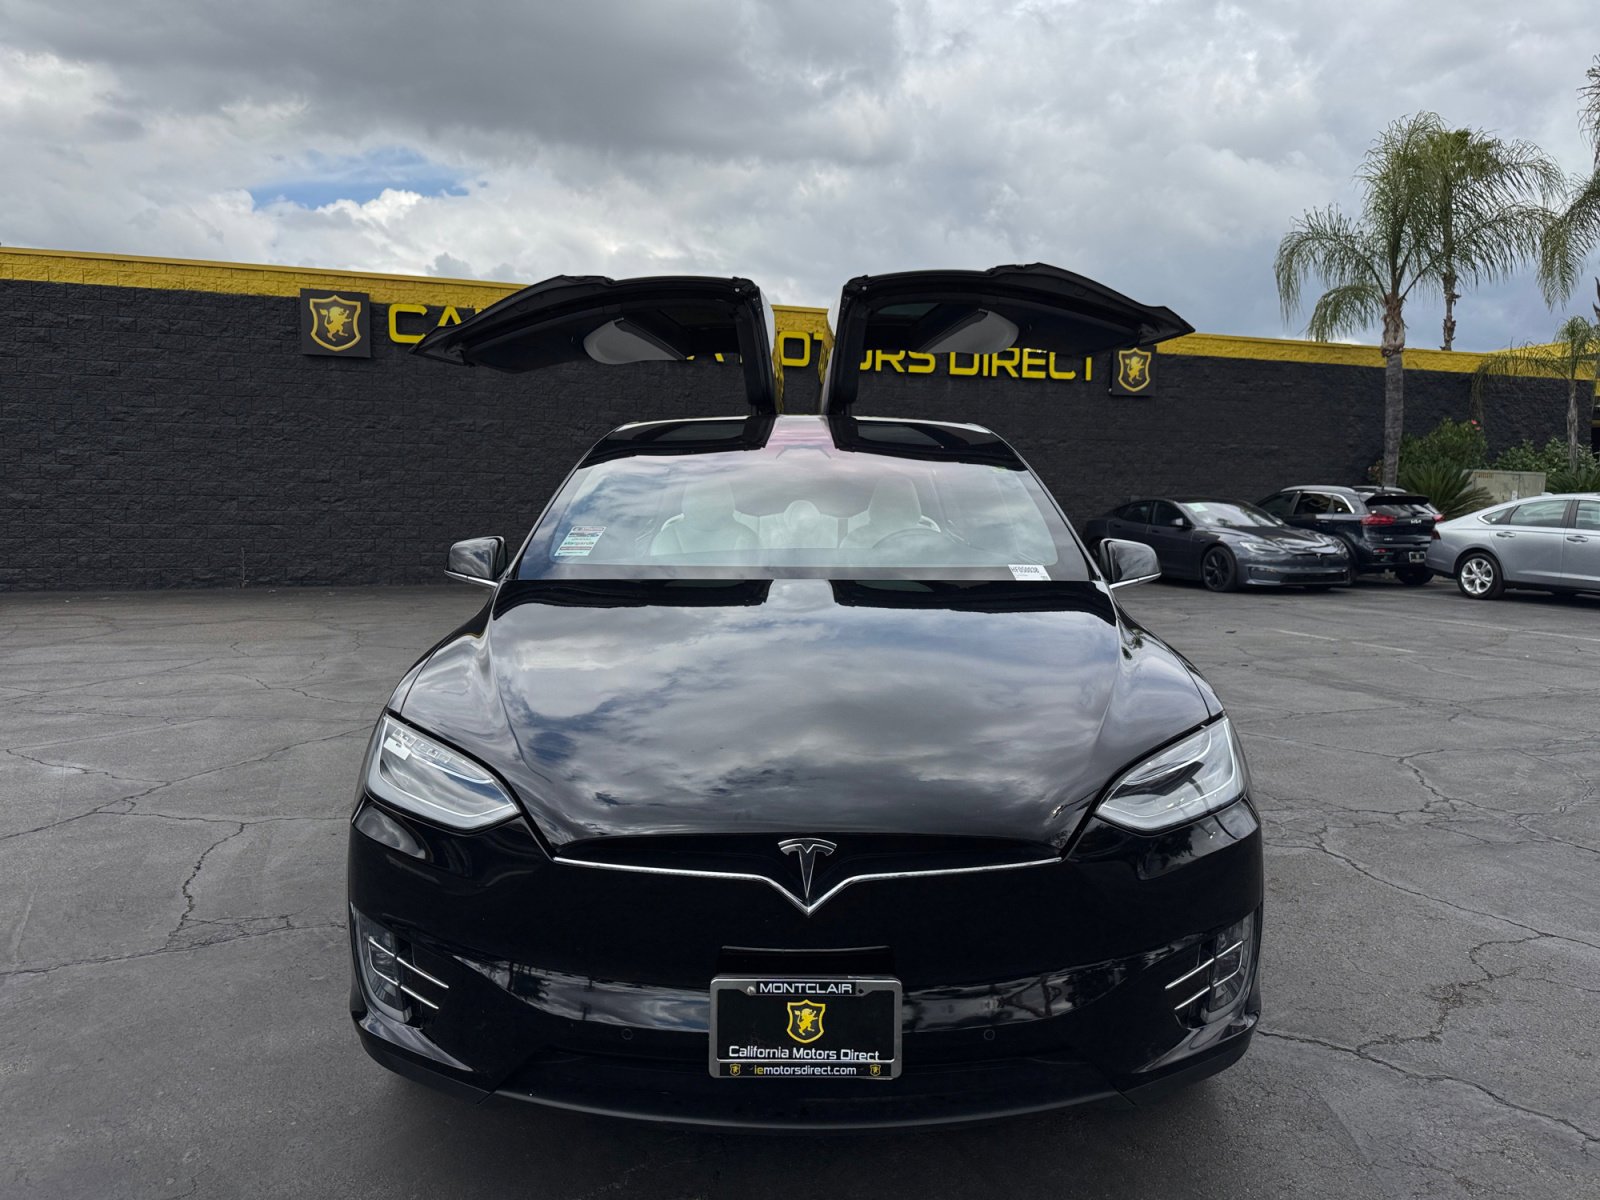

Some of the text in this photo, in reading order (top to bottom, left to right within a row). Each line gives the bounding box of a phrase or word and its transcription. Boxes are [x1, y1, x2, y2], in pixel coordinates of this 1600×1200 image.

[759, 983, 852, 994] MONTCLAIR
[728, 1045, 880, 1061] California Motors Direct
[754, 1064, 857, 1075] iemotorsdirect.com
